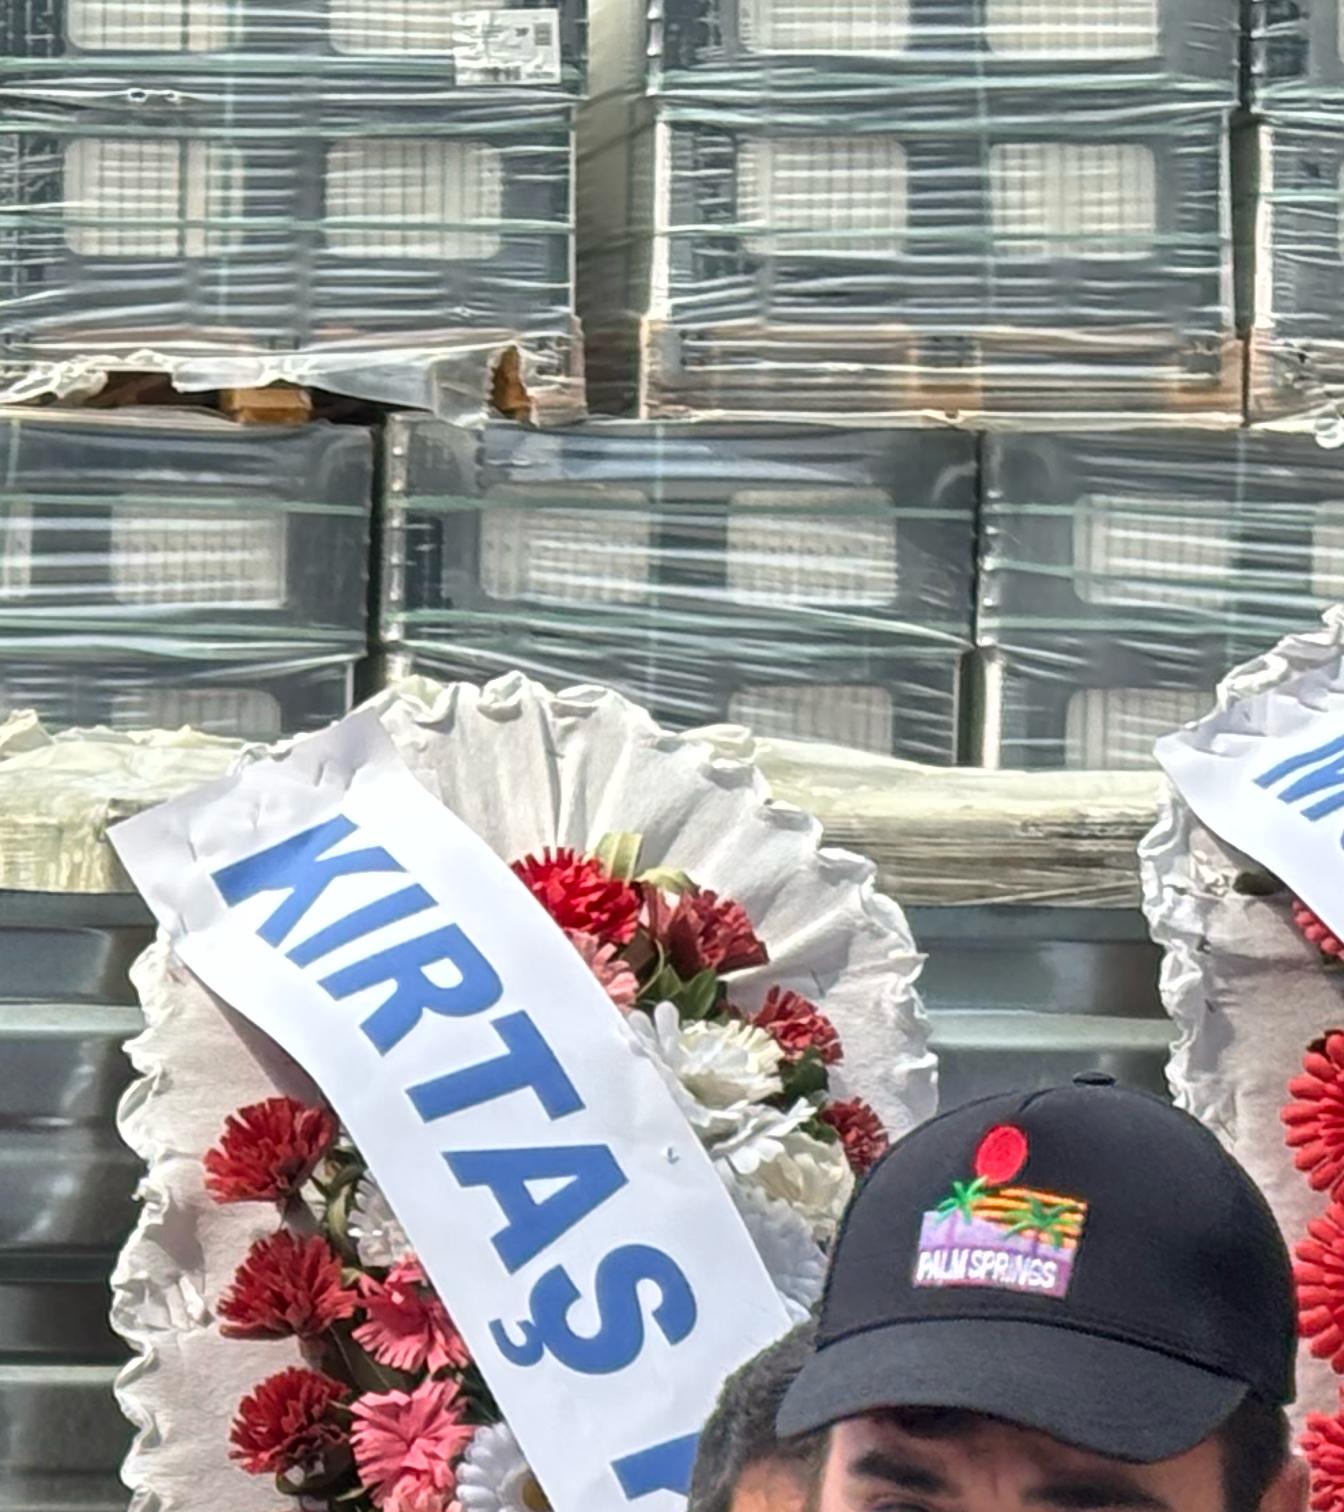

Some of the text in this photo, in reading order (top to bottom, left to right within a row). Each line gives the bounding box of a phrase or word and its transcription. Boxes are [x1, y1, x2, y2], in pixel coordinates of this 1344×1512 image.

[210, 814, 699, 1375] KIRTAŞ
[916, 1249, 1057, 1288] PALM SPRINGS
